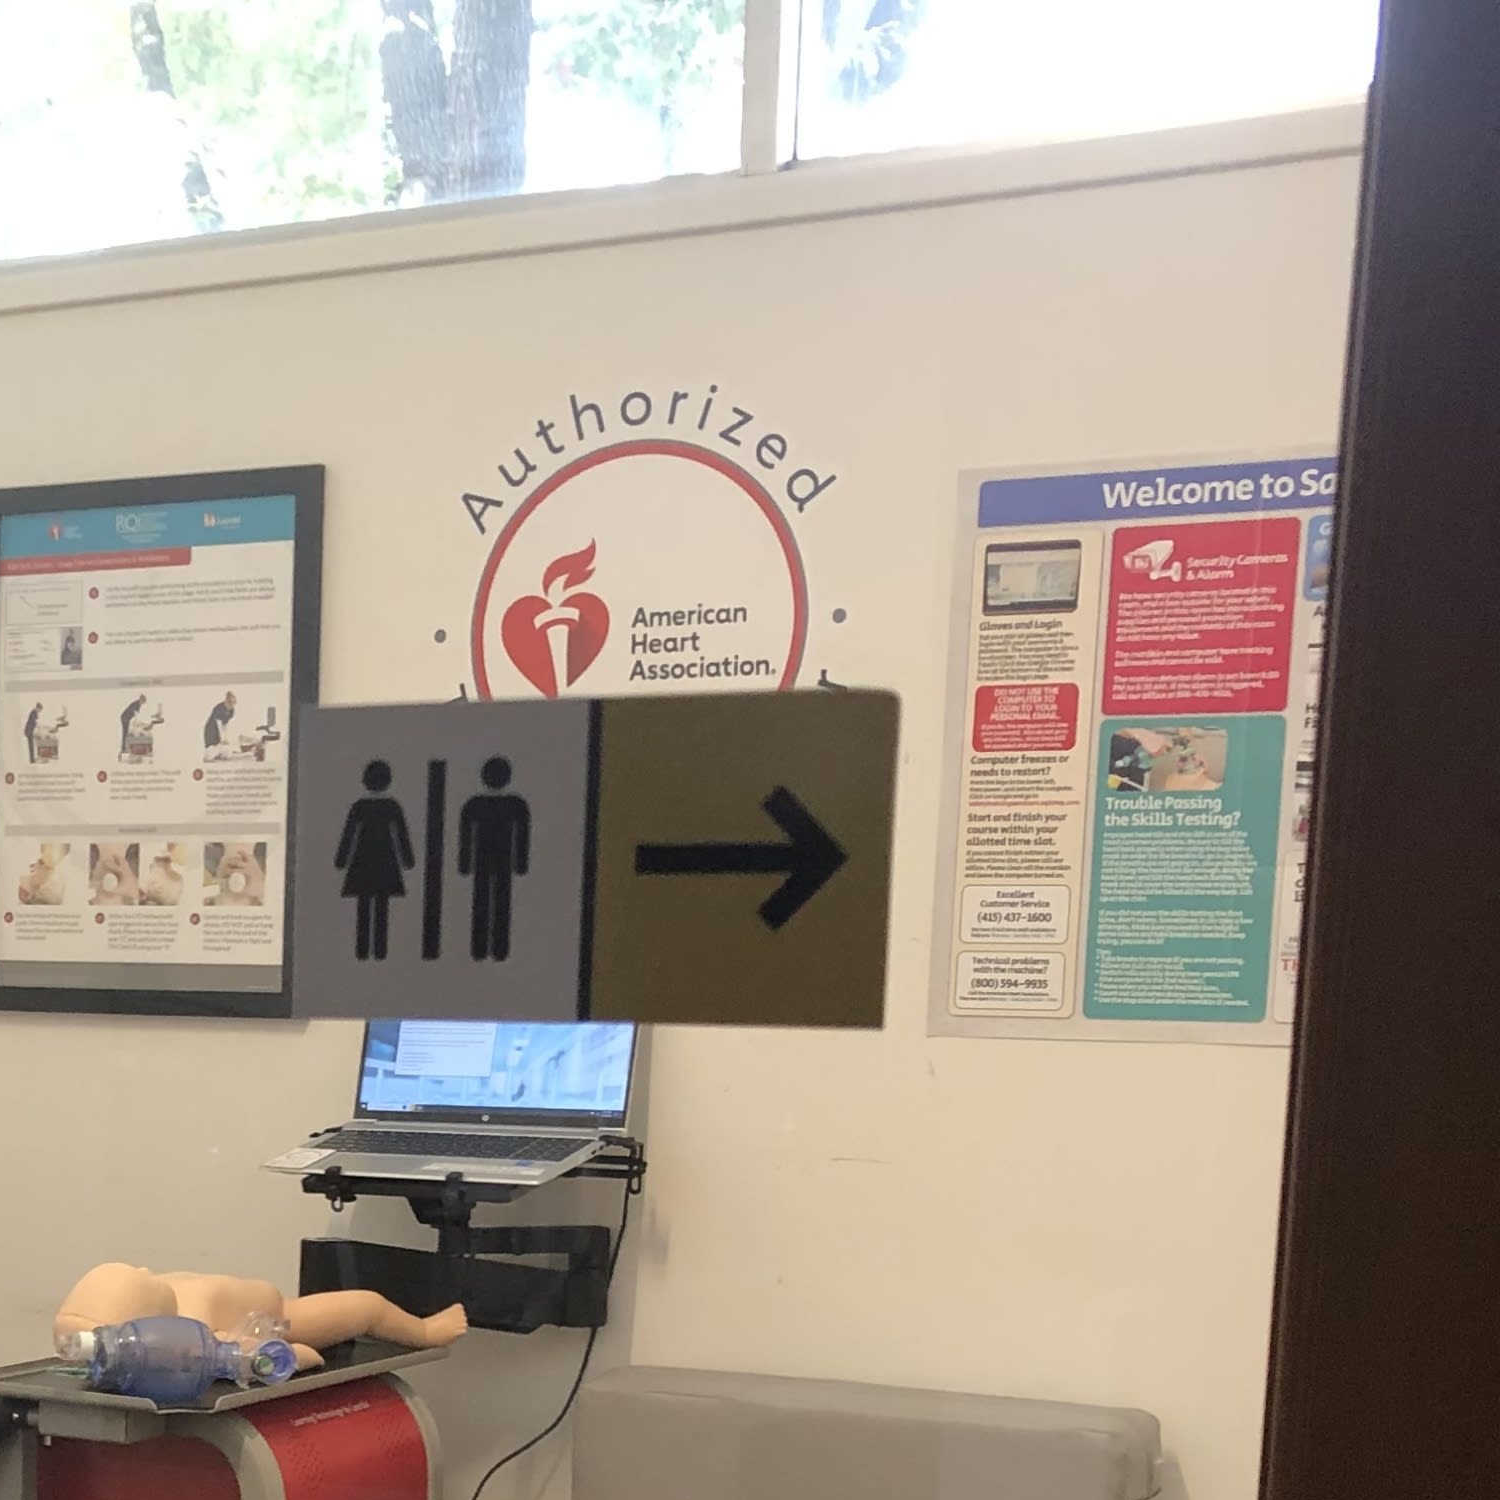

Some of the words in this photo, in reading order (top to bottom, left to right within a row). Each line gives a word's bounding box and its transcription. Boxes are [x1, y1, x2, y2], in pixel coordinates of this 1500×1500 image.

[462, 385, 836, 534] Authorized
[1102, 477, 1253, 509] Welcome
[1260, 474, 1294, 500] to
[631, 603, 748, 629] American
[630, 632, 701, 656] Heart
[970, 755, 1020, 767] Computer
[1059, 755, 1070, 764] or
[970, 767, 999, 777] needs
[1001, 768, 1012, 777] to
[1104, 796, 1163, 810] Trouble
[1164, 795, 1222, 813] Passing
[968, 812, 992, 823] Start
[993, 812, 1012, 822] and
[1013, 811, 1044, 822] finish
[1044, 813, 1068, 824] your
[1104, 811, 1129, 827] the
[1131, 810, 1174, 827] Skills
[1176, 810, 1241, 829] Testing?
[966, 826, 1000, 835] course
[1000, 824, 1035, 835] within
[1036, 825, 1059, 836] your
[966, 836, 1006, 847] allotted
[1008, 836, 1031, 847] time
[1033, 836, 1057, 847] slot.
[996, 890, 1035, 899] Excellent
[979, 899, 1019, 908] Customer
[1020, 899, 1051, 908] Service
[977, 911, 1002, 924] (415)
[972, 956, 1011, 965] Technical
[1011, 956, 1050, 967] problems
[973, 966, 992, 974] with
[993, 966, 1006, 974] the
[970, 978, 999, 990] (800)
